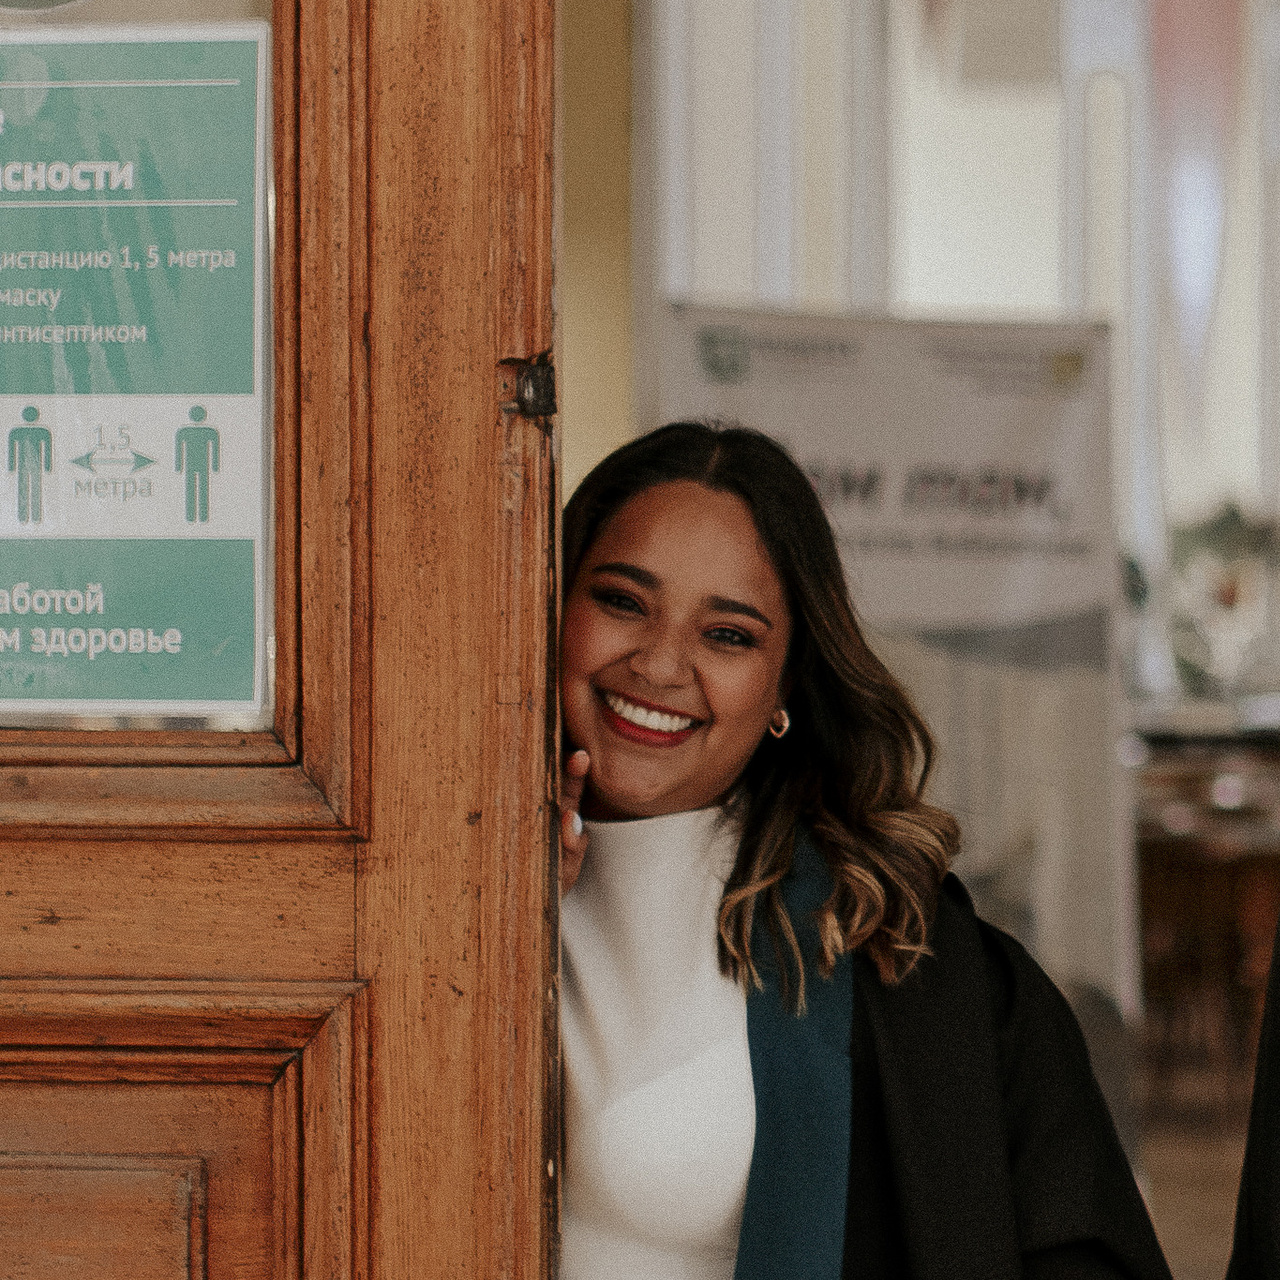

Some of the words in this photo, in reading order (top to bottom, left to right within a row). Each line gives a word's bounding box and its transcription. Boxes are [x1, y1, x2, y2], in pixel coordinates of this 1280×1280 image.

[0, 161, 135, 191] сности
[0, 249, 112, 271] истанцию
[168, 248, 237, 271] метра
[92, 424, 132, 453] 1,5
[73, 477, 154, 502] метра
[30, 627, 182, 660] здоровье
